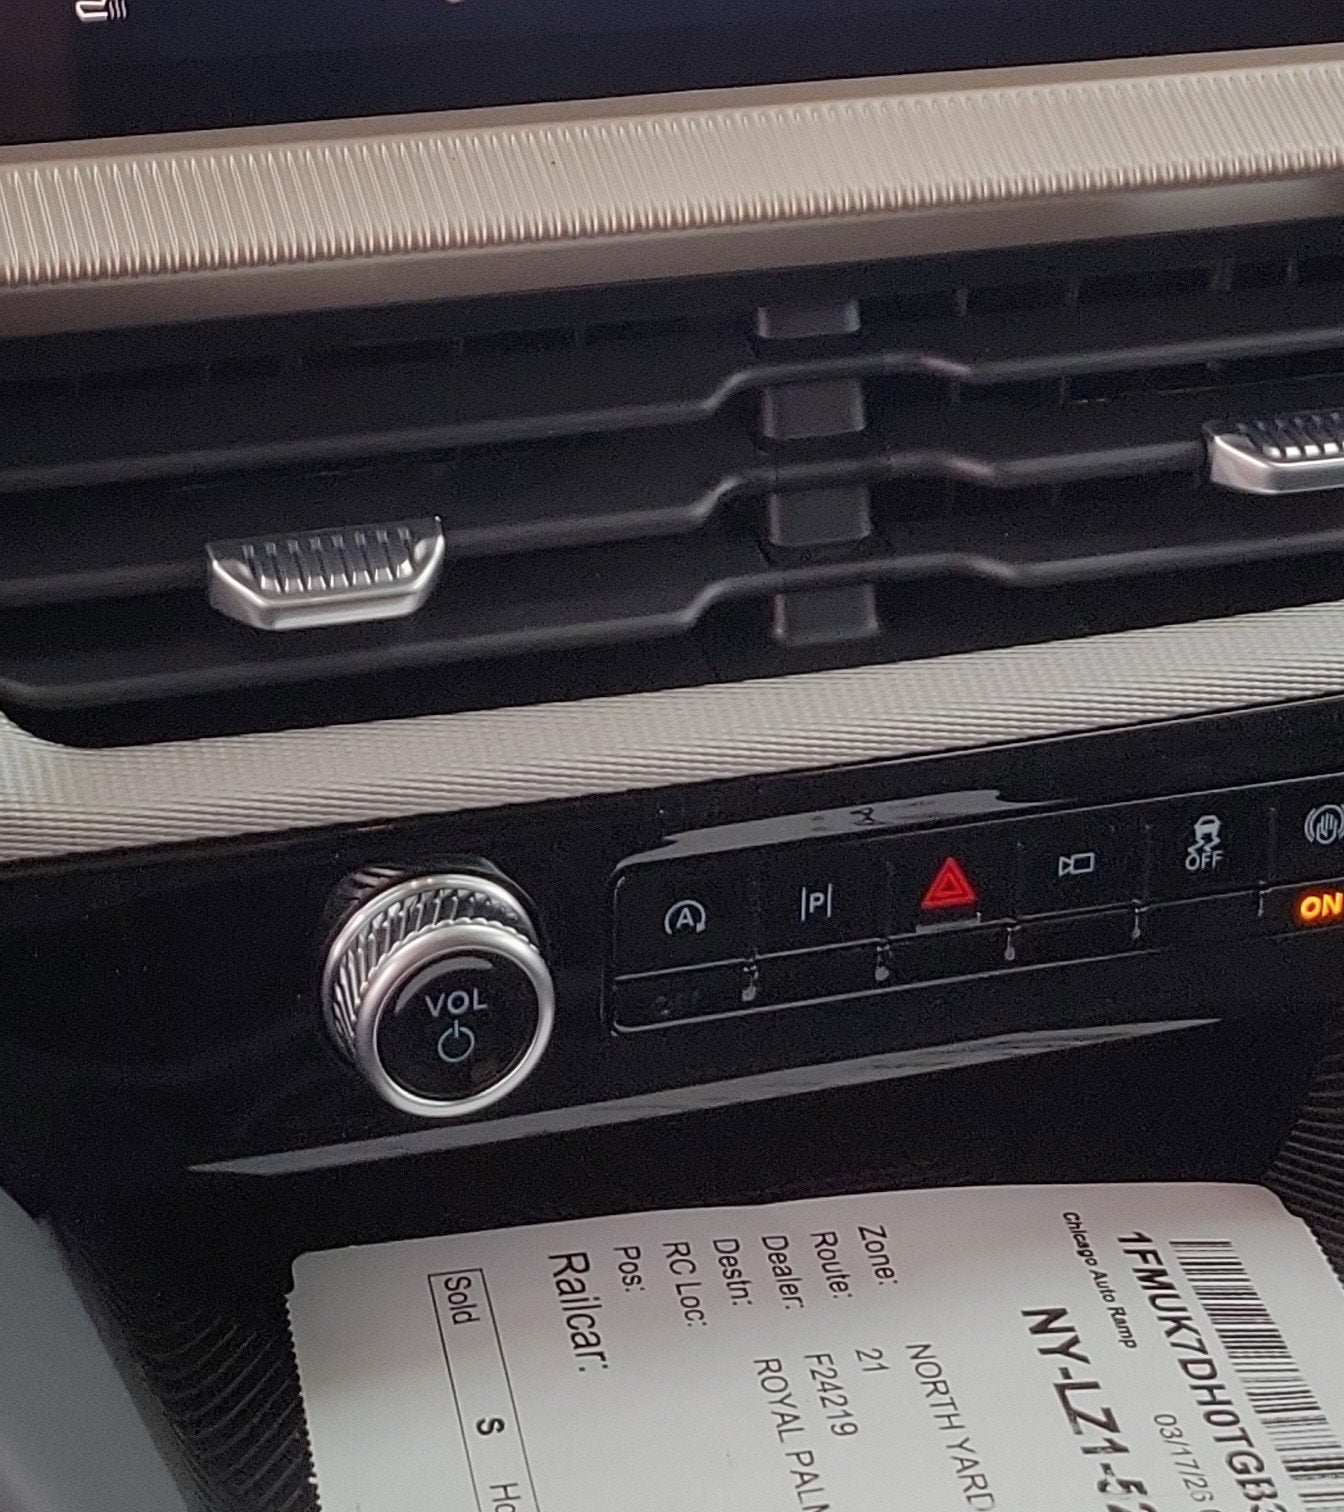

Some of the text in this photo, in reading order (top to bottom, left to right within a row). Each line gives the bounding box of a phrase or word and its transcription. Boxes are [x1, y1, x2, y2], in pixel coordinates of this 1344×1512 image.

[1184, 848, 1225, 872] OFF
[1300, 892, 1344, 919] ON
[424, 987, 488, 1018] VOL
[614, 1244, 646, 1293] Pos:
[663, 1241, 708, 1328] RC Loc:
[711, 1238, 753, 1307] Destn:
[761, 1234, 805, 1311] Dealer:
[855, 1224, 899, 1372] Zone: 21
[1062, 1211, 1138, 1349] Chicago Auto Ramp
[548, 1251, 610, 1373] Railcar:
[804, 1230, 859, 1437] Route: F24219
[443, 1276, 480, 1325] Sold
[476, 1418, 505, 1436] S
[753, 1358, 804, 1443] ROYAL
[905, 1343, 995, 1512] NORTH YARD
